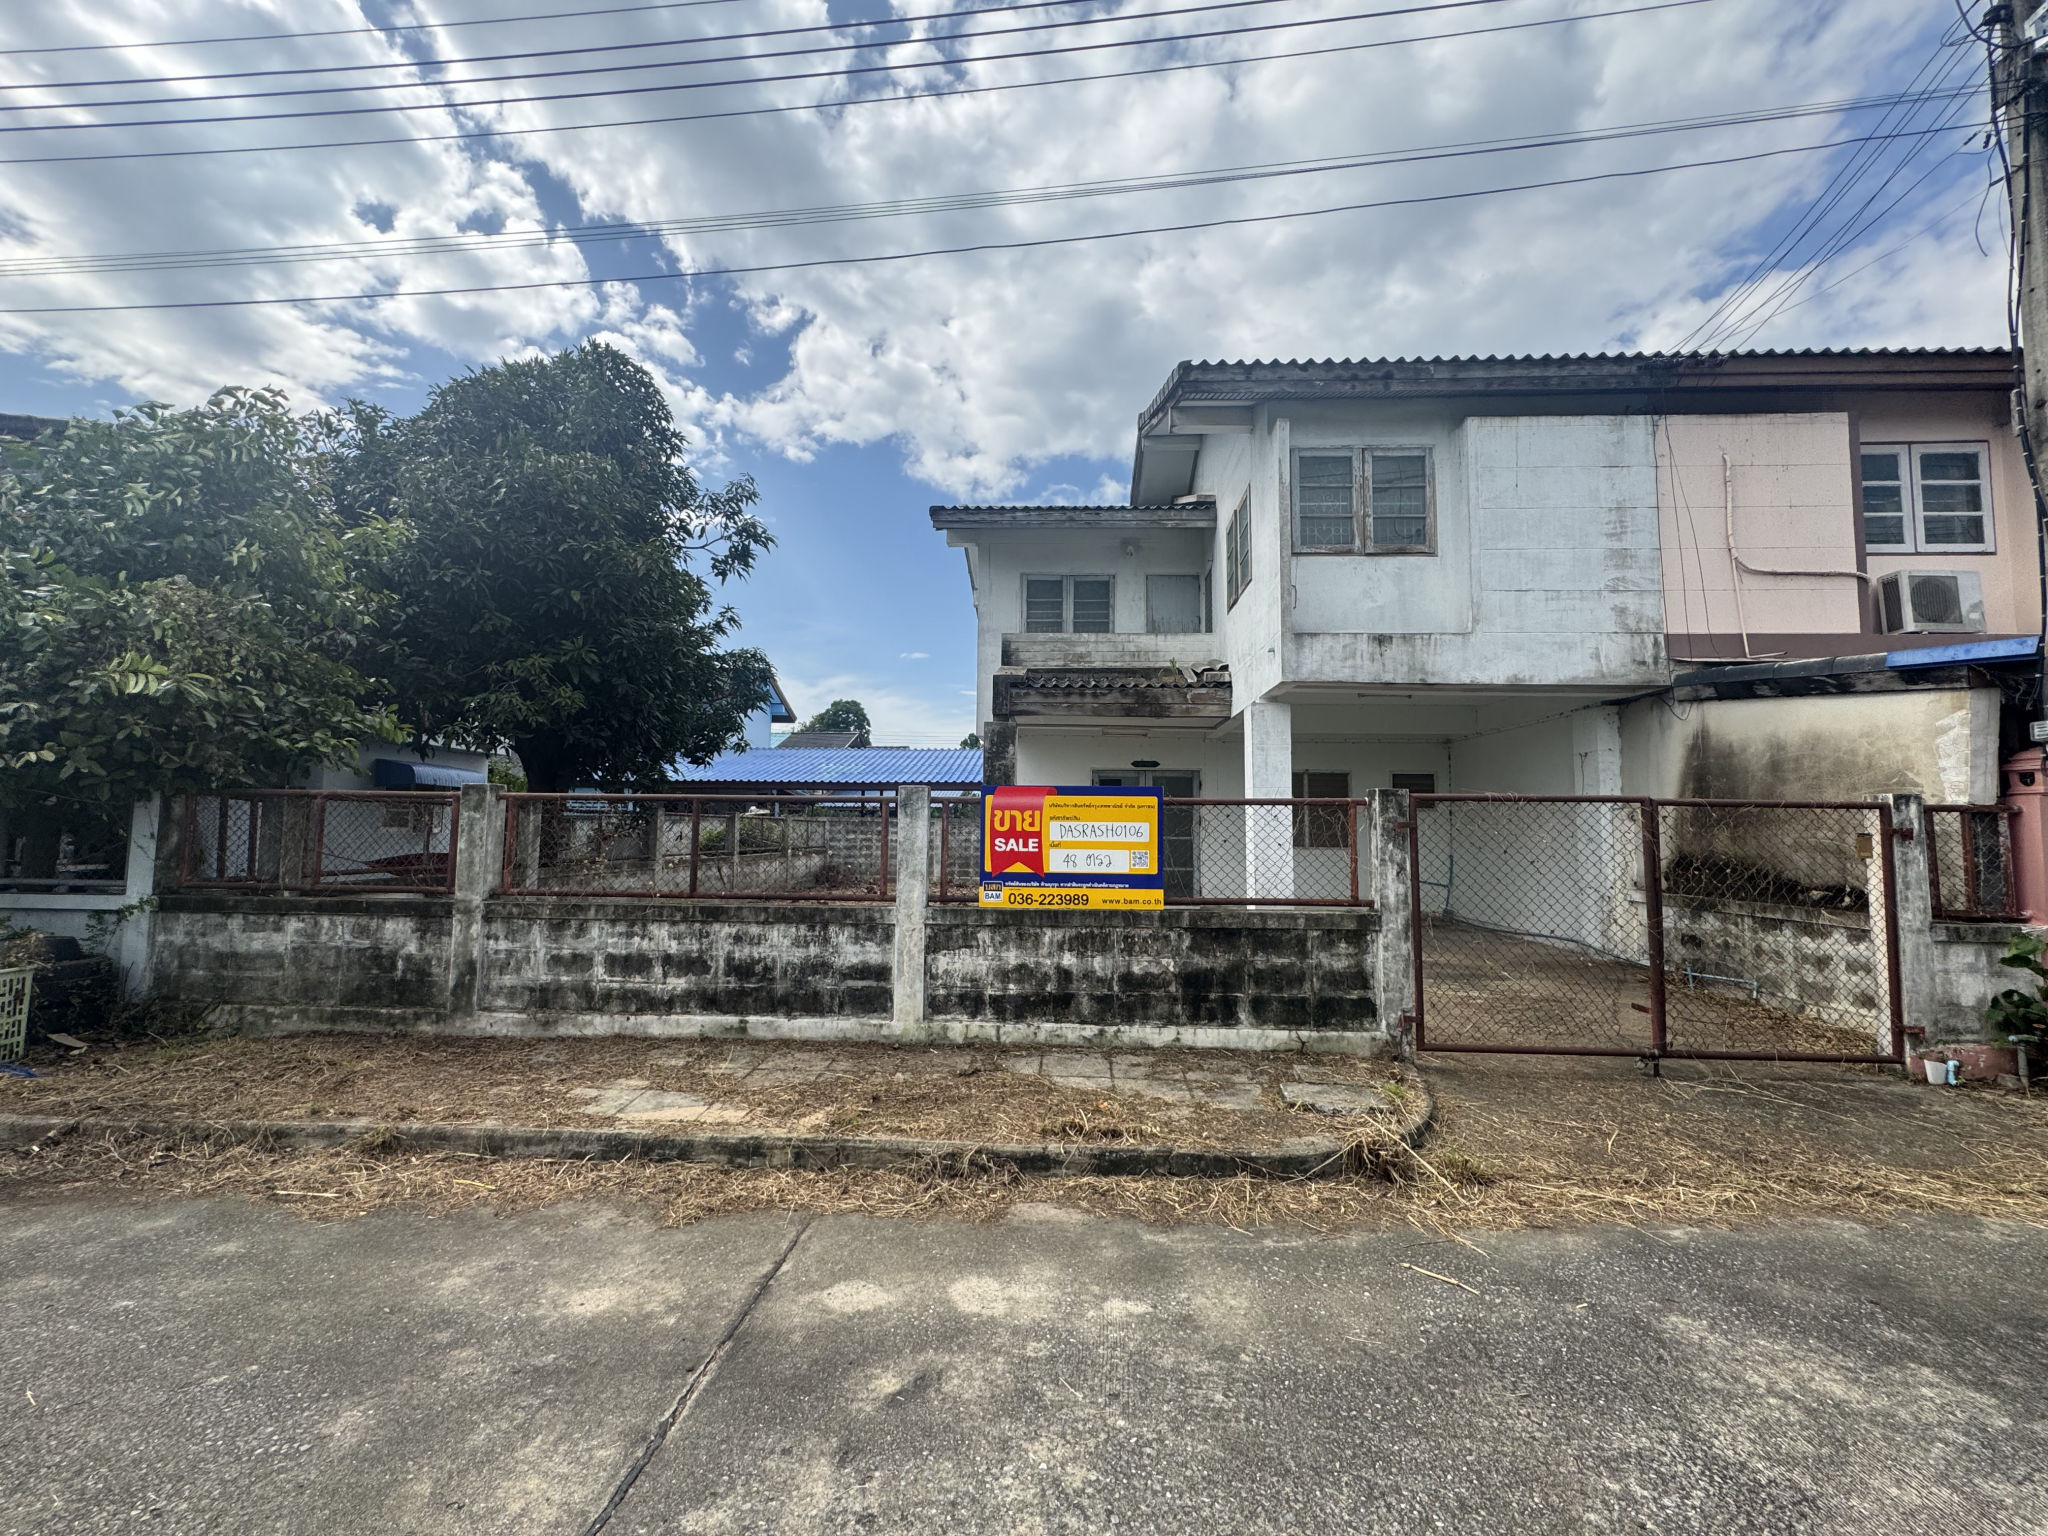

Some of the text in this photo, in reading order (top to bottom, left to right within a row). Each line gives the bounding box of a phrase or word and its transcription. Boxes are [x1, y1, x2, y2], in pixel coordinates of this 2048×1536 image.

[993, 809, 1041, 831] ขาย
[994, 837, 1039, 852] SALE
[1063, 853, 1077, 869] 48
[1008, 892, 1089, 906] 036-223989
[1101, 897, 1162, 905] www.bam.co.th
